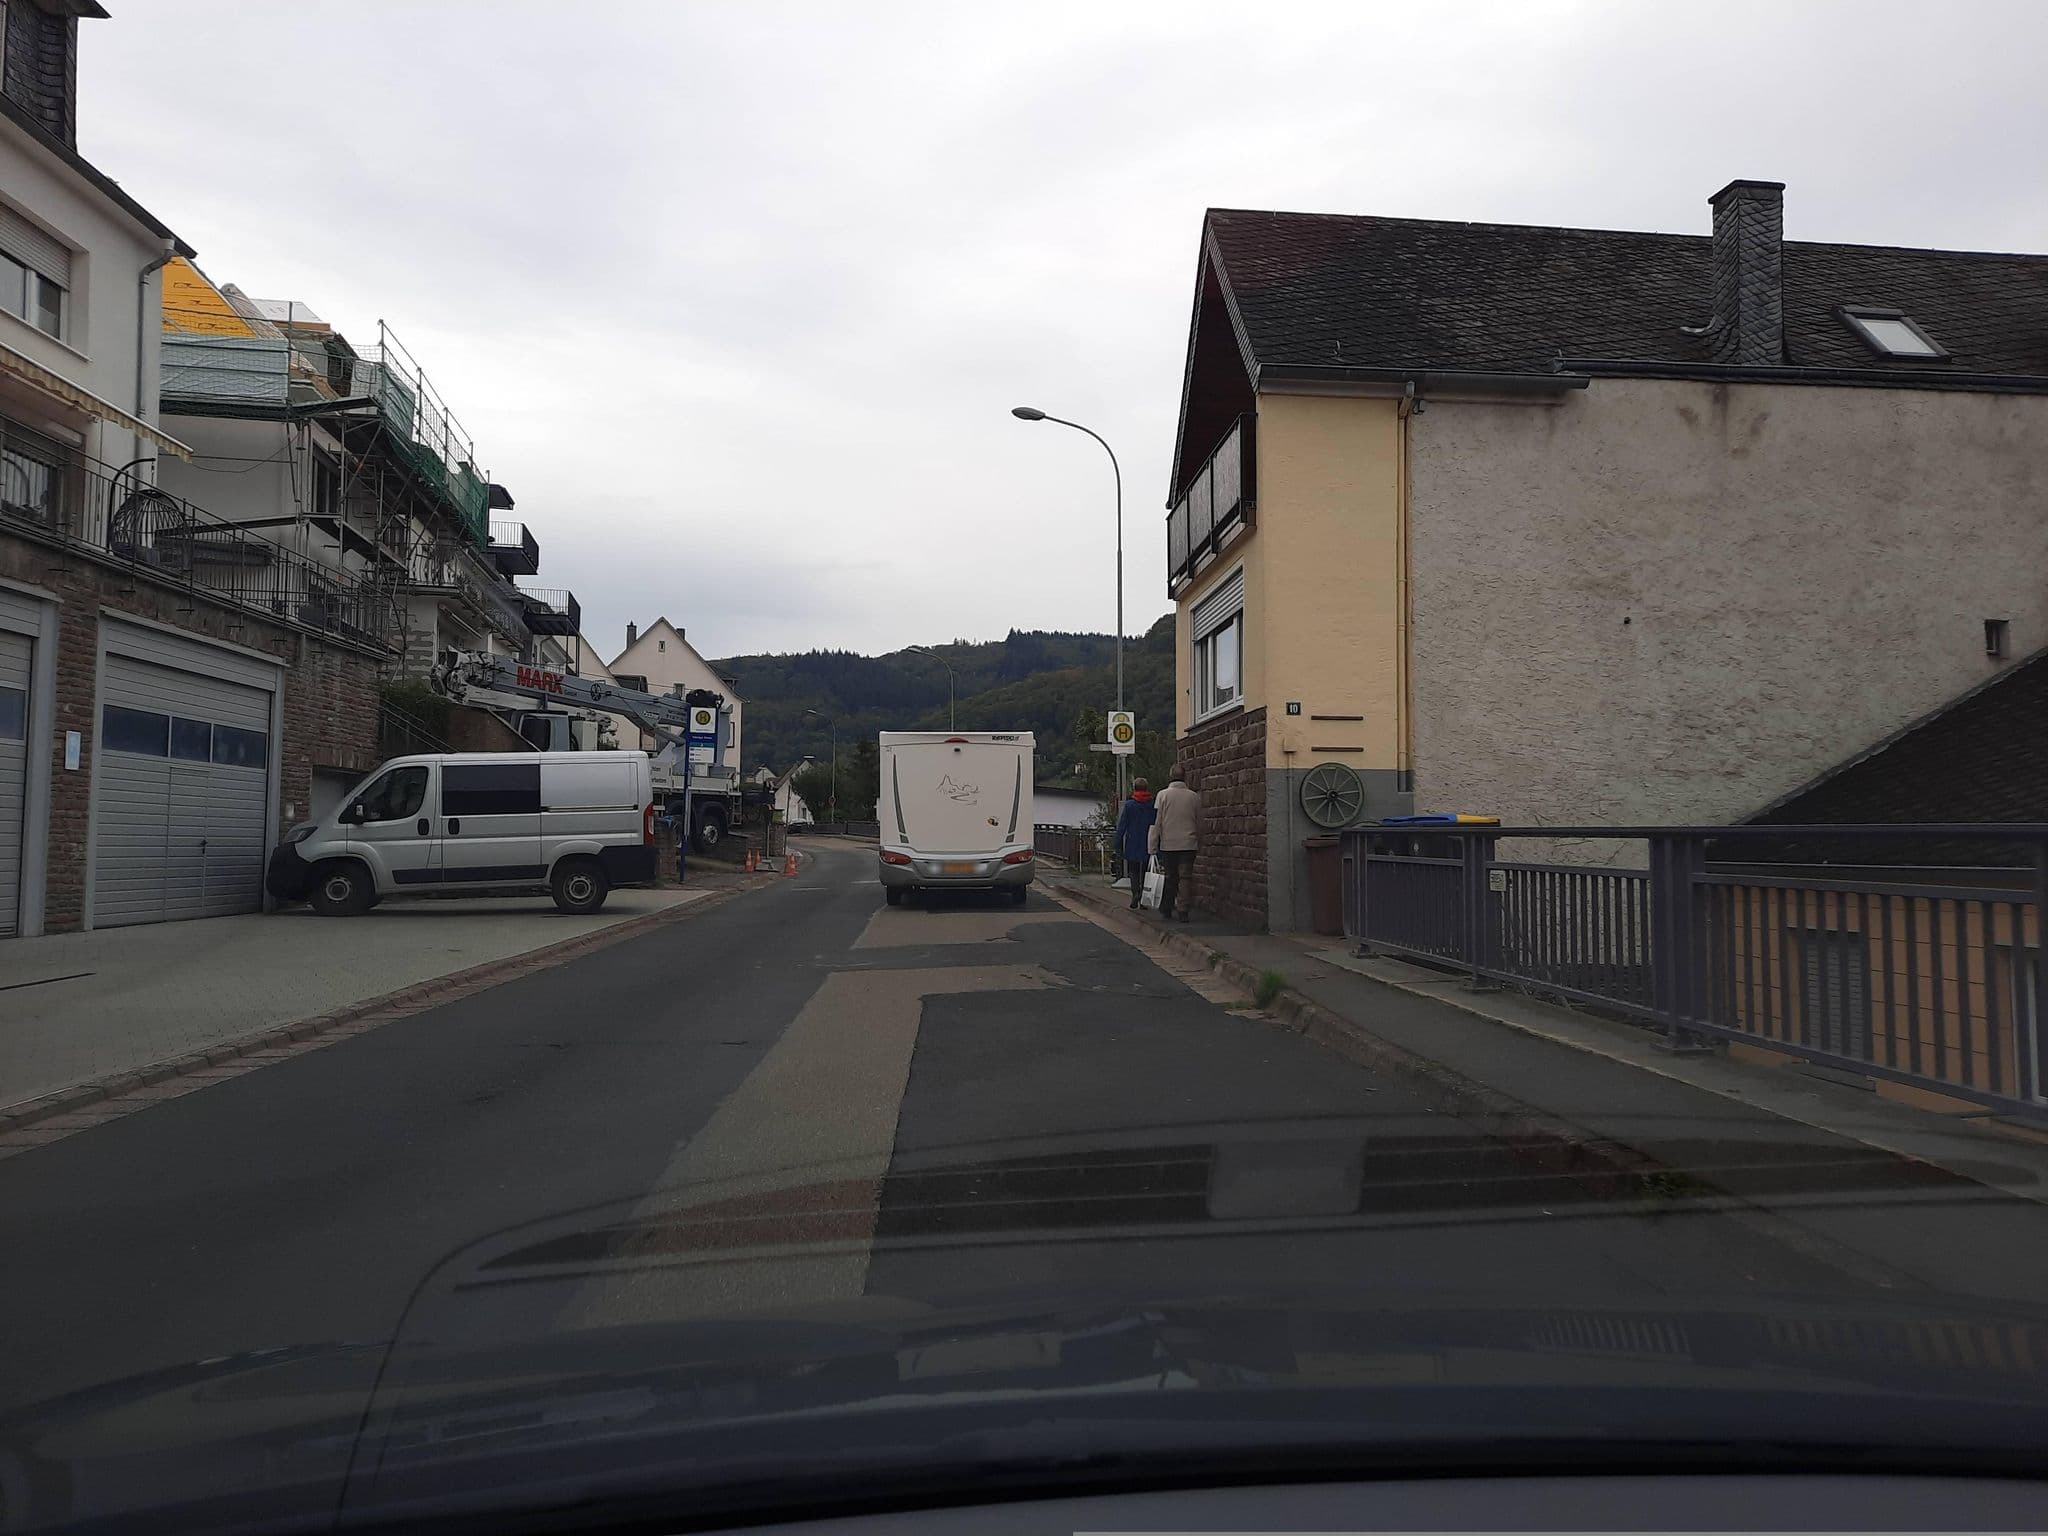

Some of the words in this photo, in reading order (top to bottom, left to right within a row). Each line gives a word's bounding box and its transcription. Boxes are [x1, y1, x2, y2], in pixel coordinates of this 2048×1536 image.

[517, 666, 564, 694] MARX
[1289, 704, 1298, 713] 10
[1119, 728, 1127, 738] H
